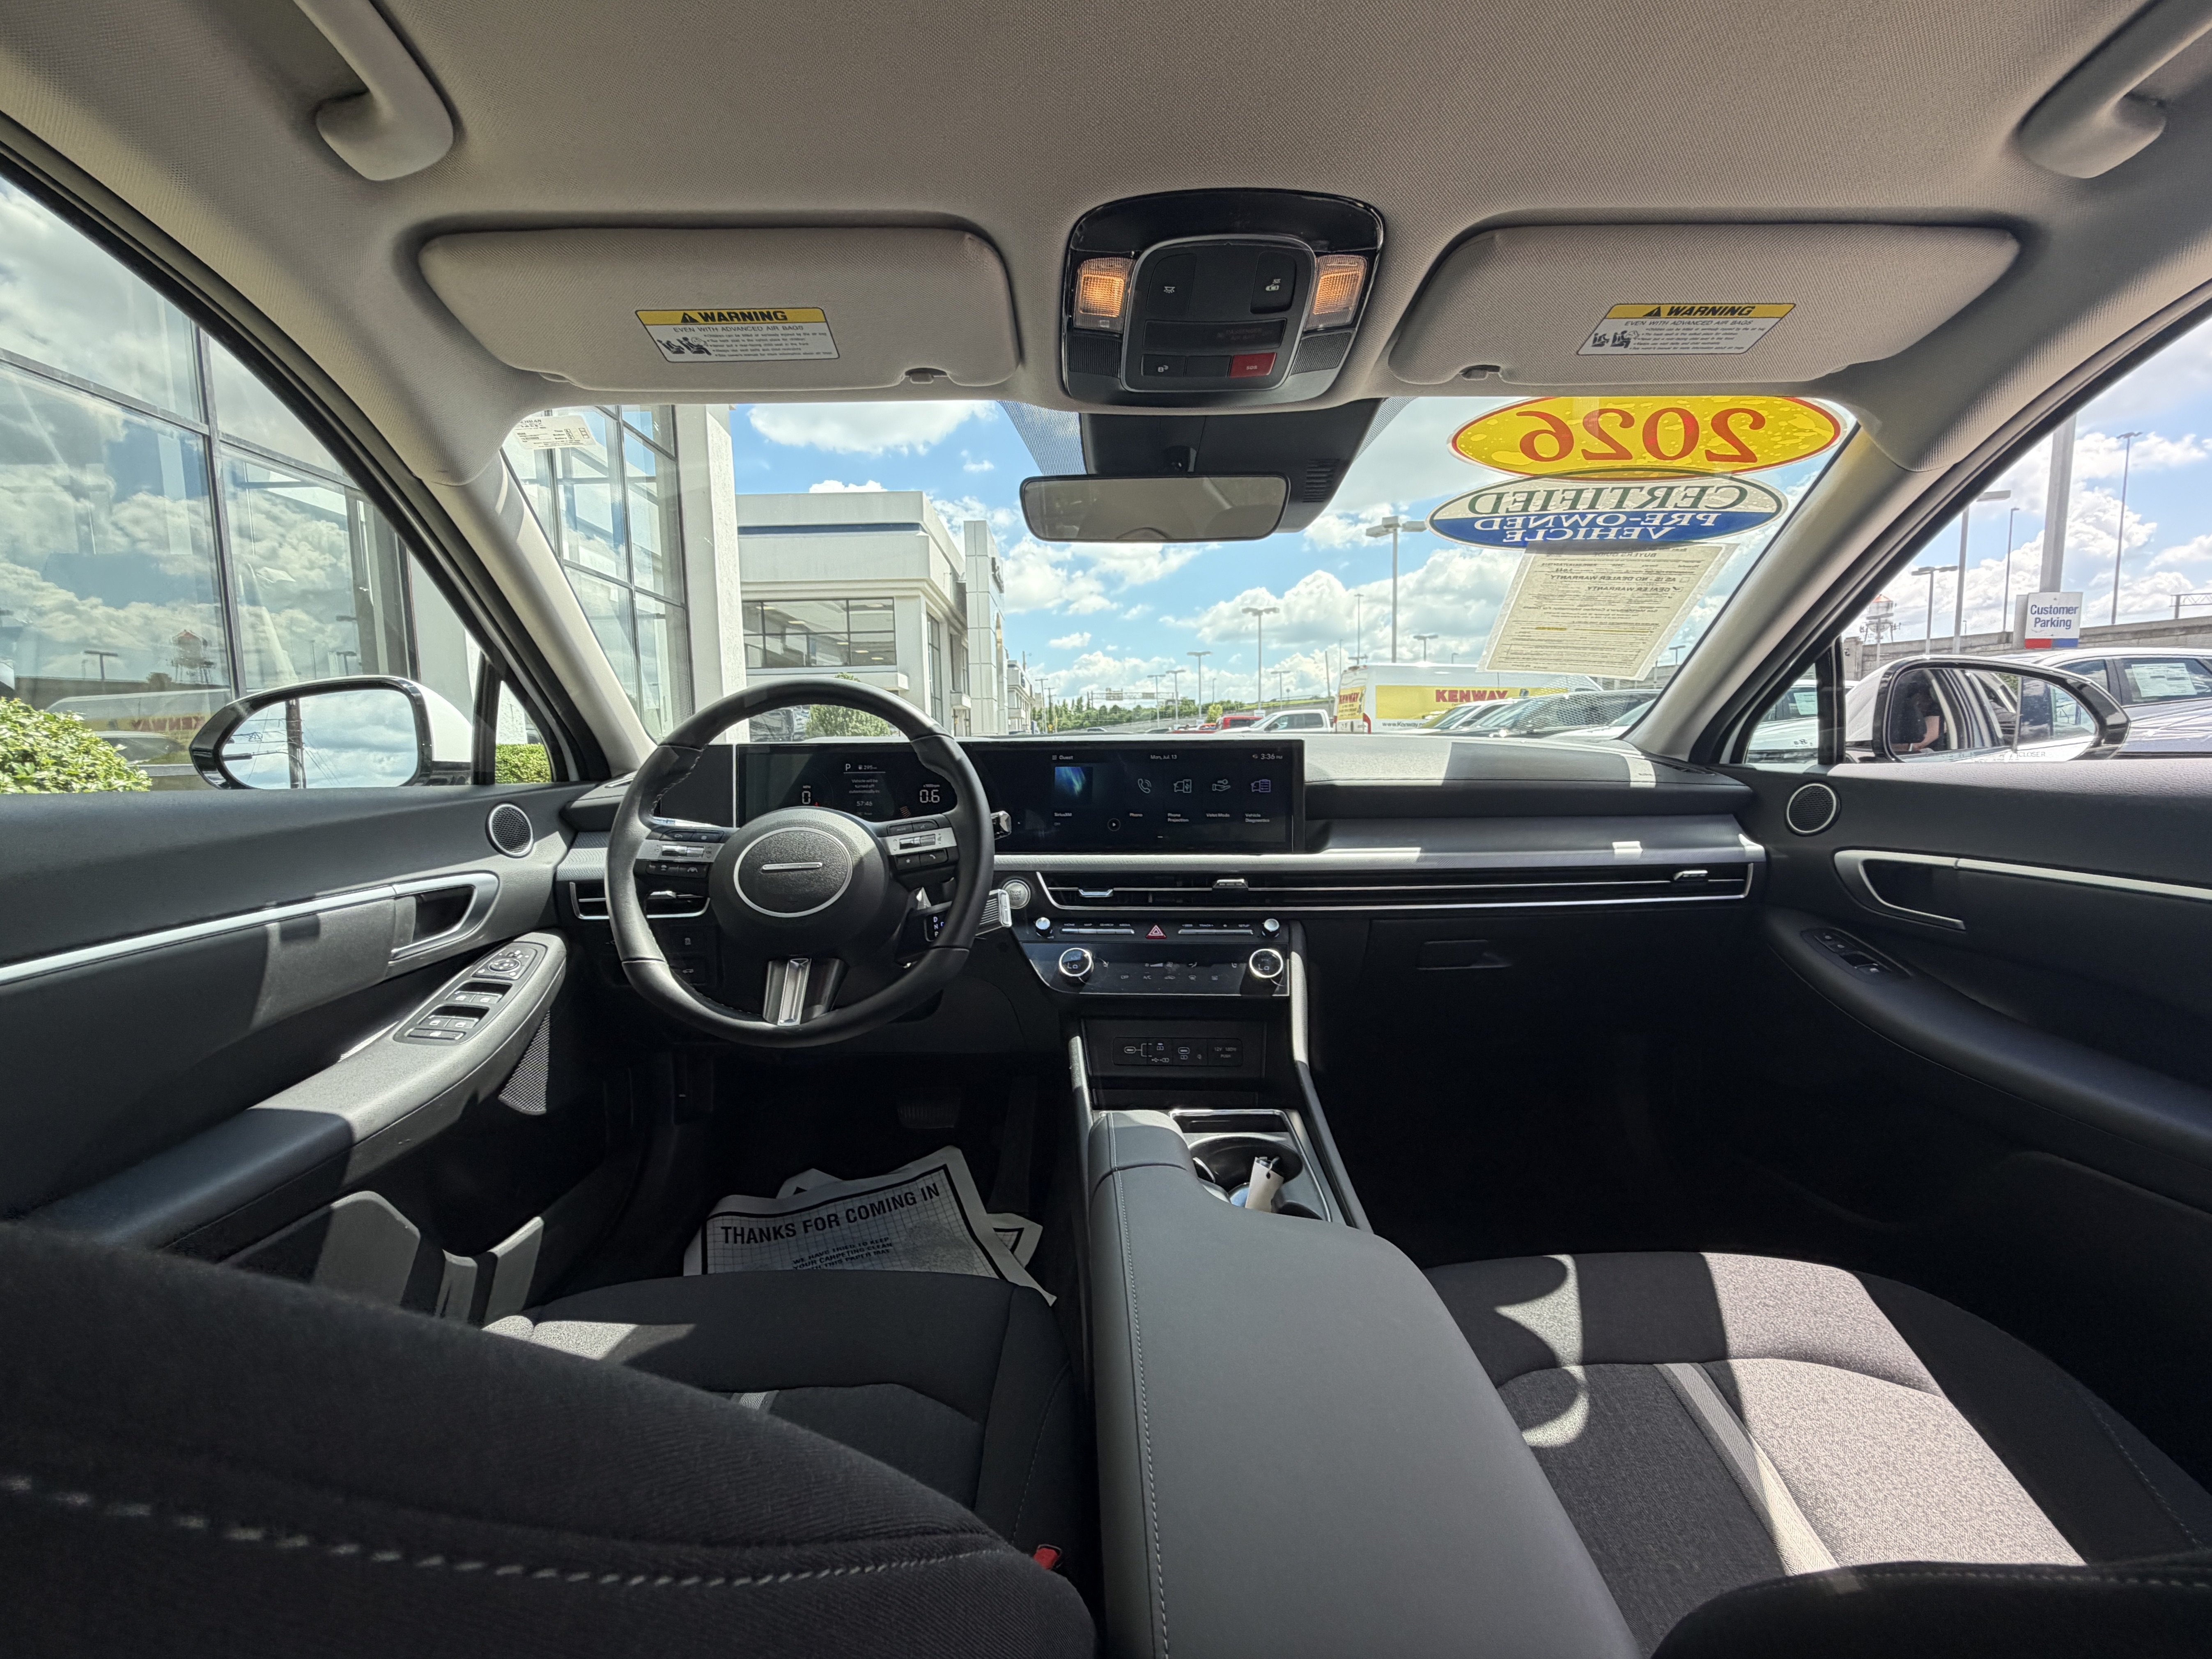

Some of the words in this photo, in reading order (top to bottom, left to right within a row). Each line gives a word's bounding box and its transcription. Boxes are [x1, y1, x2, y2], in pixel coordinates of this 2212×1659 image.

[697, 311, 788, 322] WARNING
[1667, 306, 1756, 316] WARNING
[2030, 604, 2079, 616] Customer
[2034, 617, 2072, 630] Parking
[1436, 689, 1508, 703] KENWAY
[802, 791, 811, 804] 0
[920, 789, 940, 803] 0.6
[721, 1223, 797, 1245] THANKS
[803, 1215, 841, 1234] FOR
[845, 1193, 917, 1224] COMING
[920, 1183, 940, 1201] IN
[793, 1259, 817, 1270] YOUR
[819, 1248, 865, 1263] CARPETING
[808, 1250, 830, 1259] HAVE
[845, 1252, 871, 1262] PAPER
